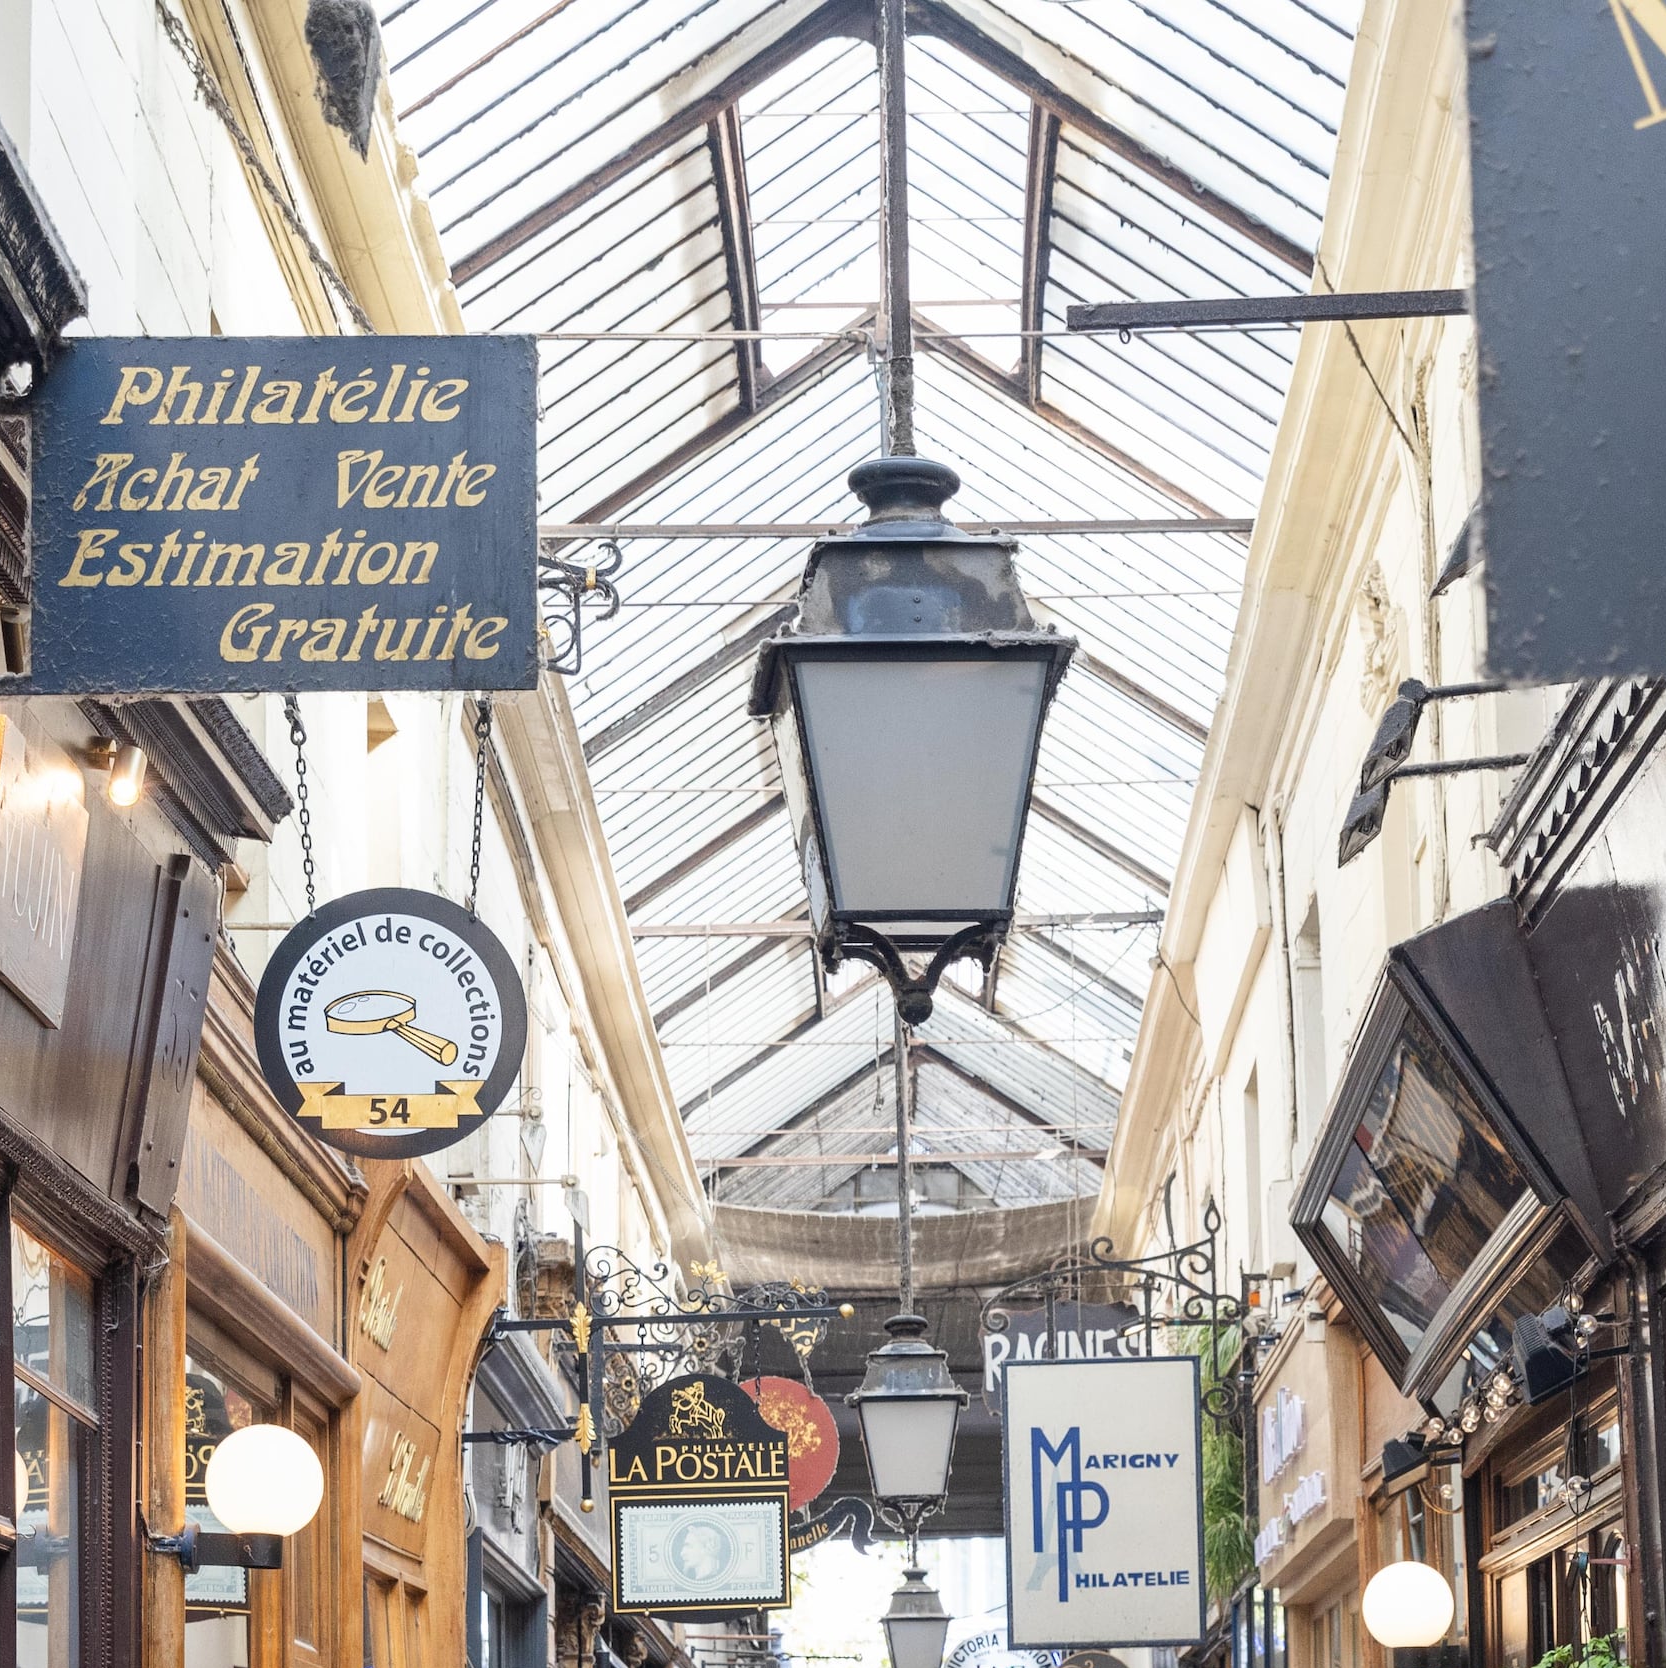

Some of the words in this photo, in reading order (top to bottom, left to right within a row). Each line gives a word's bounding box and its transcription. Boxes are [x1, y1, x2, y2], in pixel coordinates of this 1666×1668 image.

[100, 364, 470, 426] Philatélie
[73, 451, 260, 512] Achat
[336, 450, 497, 509] Vente
[59, 529, 438, 588] Estimation
[219, 602, 508, 662] Gratuite
[374, 917, 412, 945] de
[287, 921, 367, 1031] matériel
[418, 932, 496, 1078] collections
[289, 1040, 316, 1077] au
[369, 1097, 411, 1126] 54
[609, 1448, 648, 1483] LA
[655, 1445, 786, 1481] POSTALE
[681, 1441, 785, 1453] PHILATELIE
